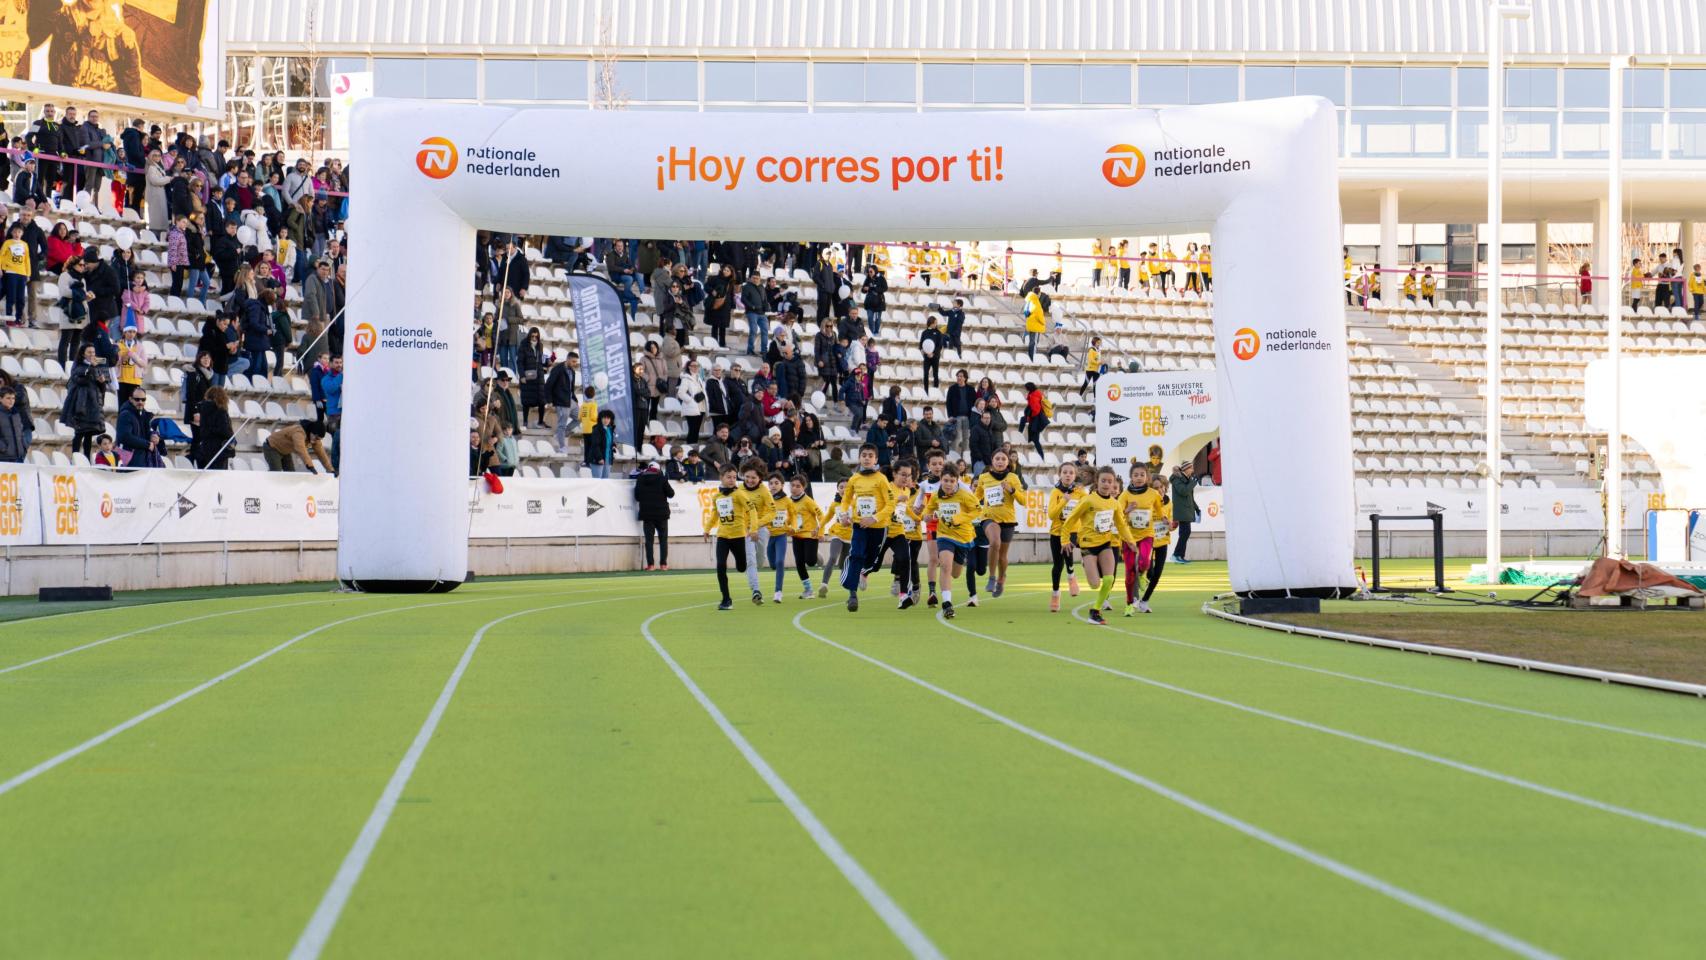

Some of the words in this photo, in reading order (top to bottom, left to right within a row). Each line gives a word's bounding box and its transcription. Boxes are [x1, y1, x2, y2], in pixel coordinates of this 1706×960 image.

[467, 147, 536, 162] nationale
[1154, 144, 1226, 161] nationale
[467, 163, 560, 178] nederlanden
[657, 146, 746, 190] ¡Hoy
[756, 155, 880, 183] corres
[892, 155, 957, 190] por
[967, 146, 1004, 181] ti!
[1154, 158, 1251, 177] nederlanden
[382, 327, 433, 338] nationale
[1266, 328, 1317, 340] nationale
[382, 338, 449, 350] nederlanden
[1266, 340, 1332, 352] nederlanden
[1172, 382, 1203, 390] SILVESTRE
